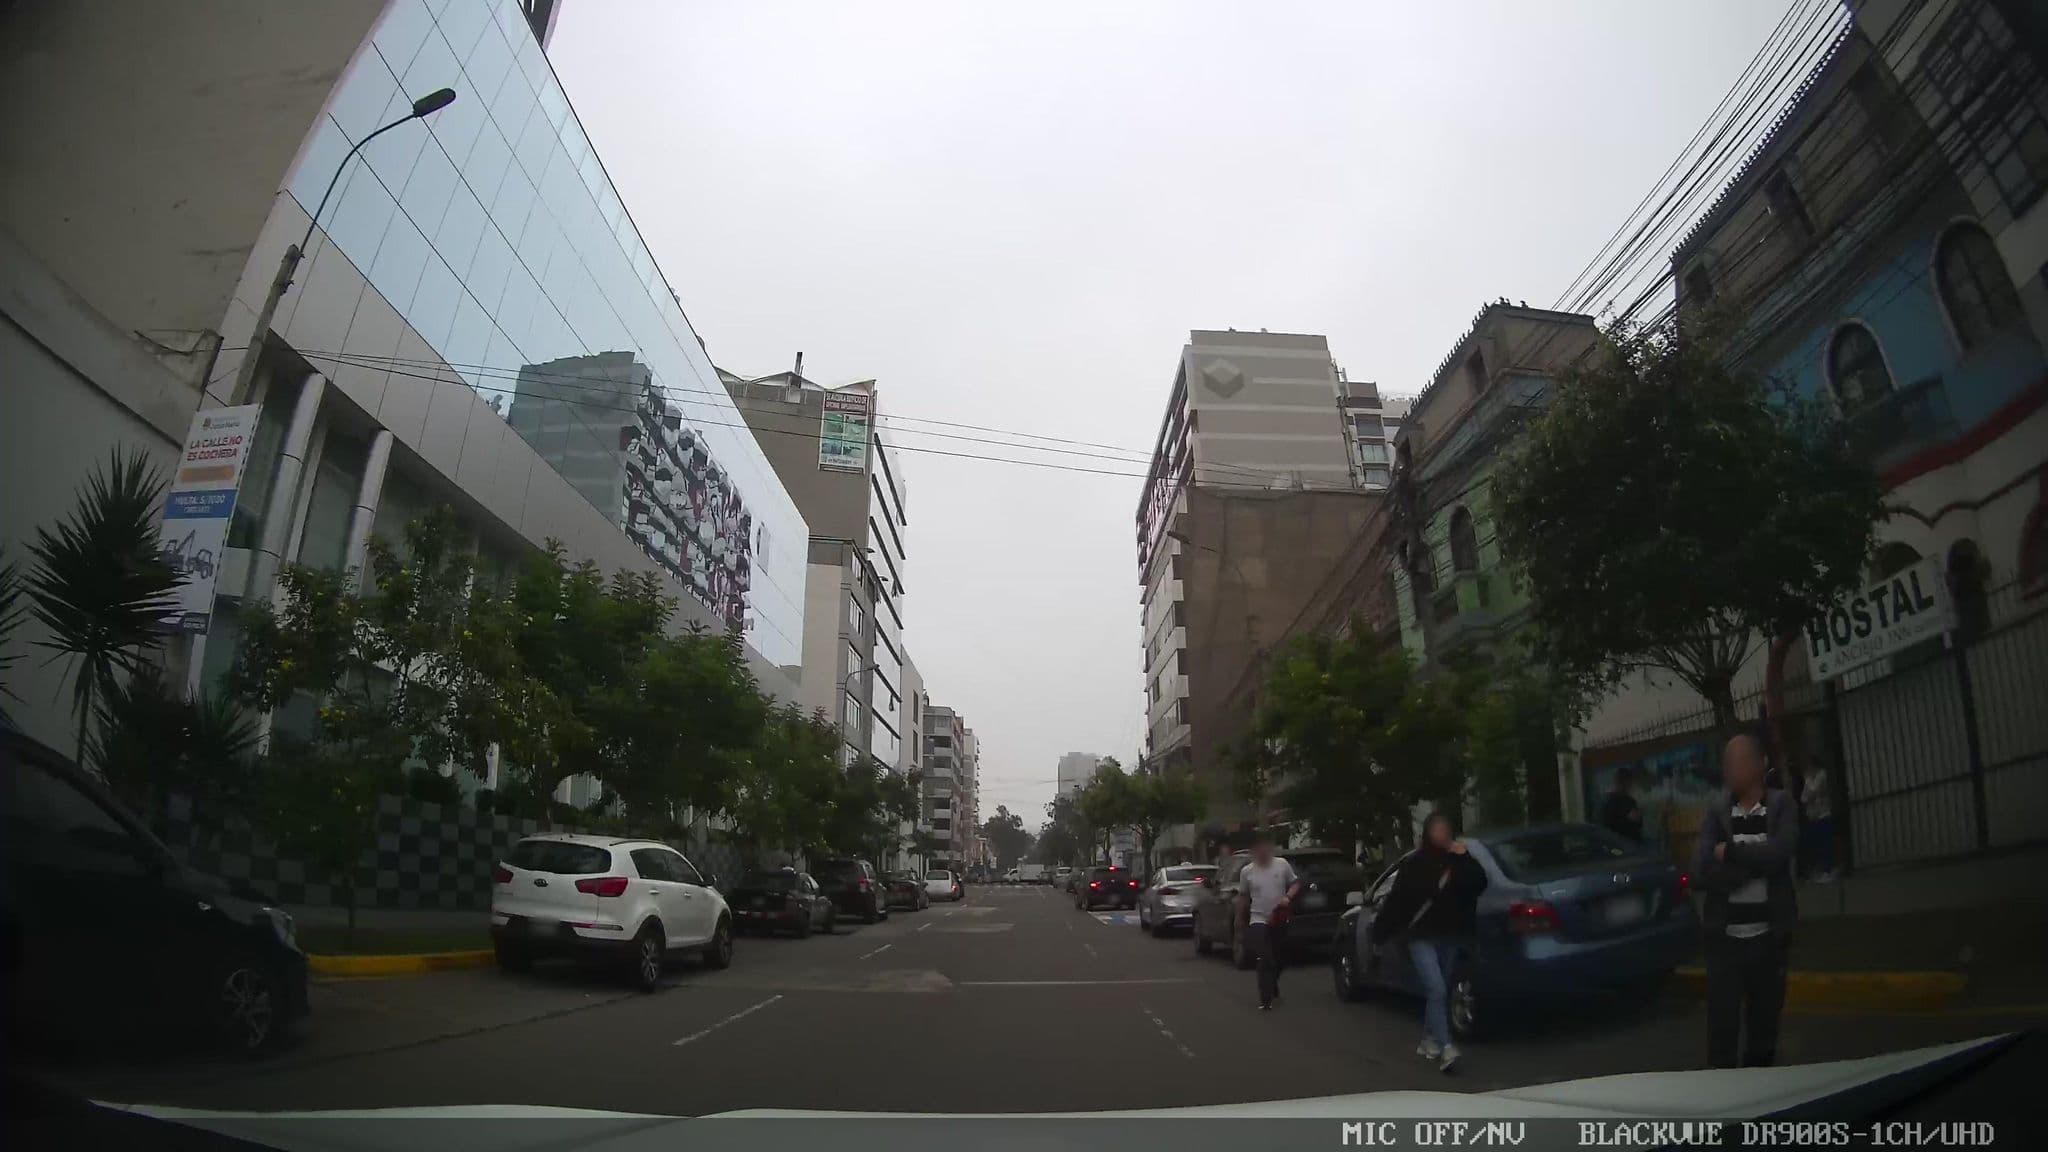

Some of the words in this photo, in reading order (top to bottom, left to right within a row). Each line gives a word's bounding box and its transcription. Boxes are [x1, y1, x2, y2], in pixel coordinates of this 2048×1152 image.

[190, 439, 200, 450] LA
[202, 437, 228, 448] CALLE
[229, 435, 243, 445] NO
[187, 451, 198, 461] ES
[199, 448, 238, 460] COCHERA
[1808, 569, 1935, 657] HOSTAL
